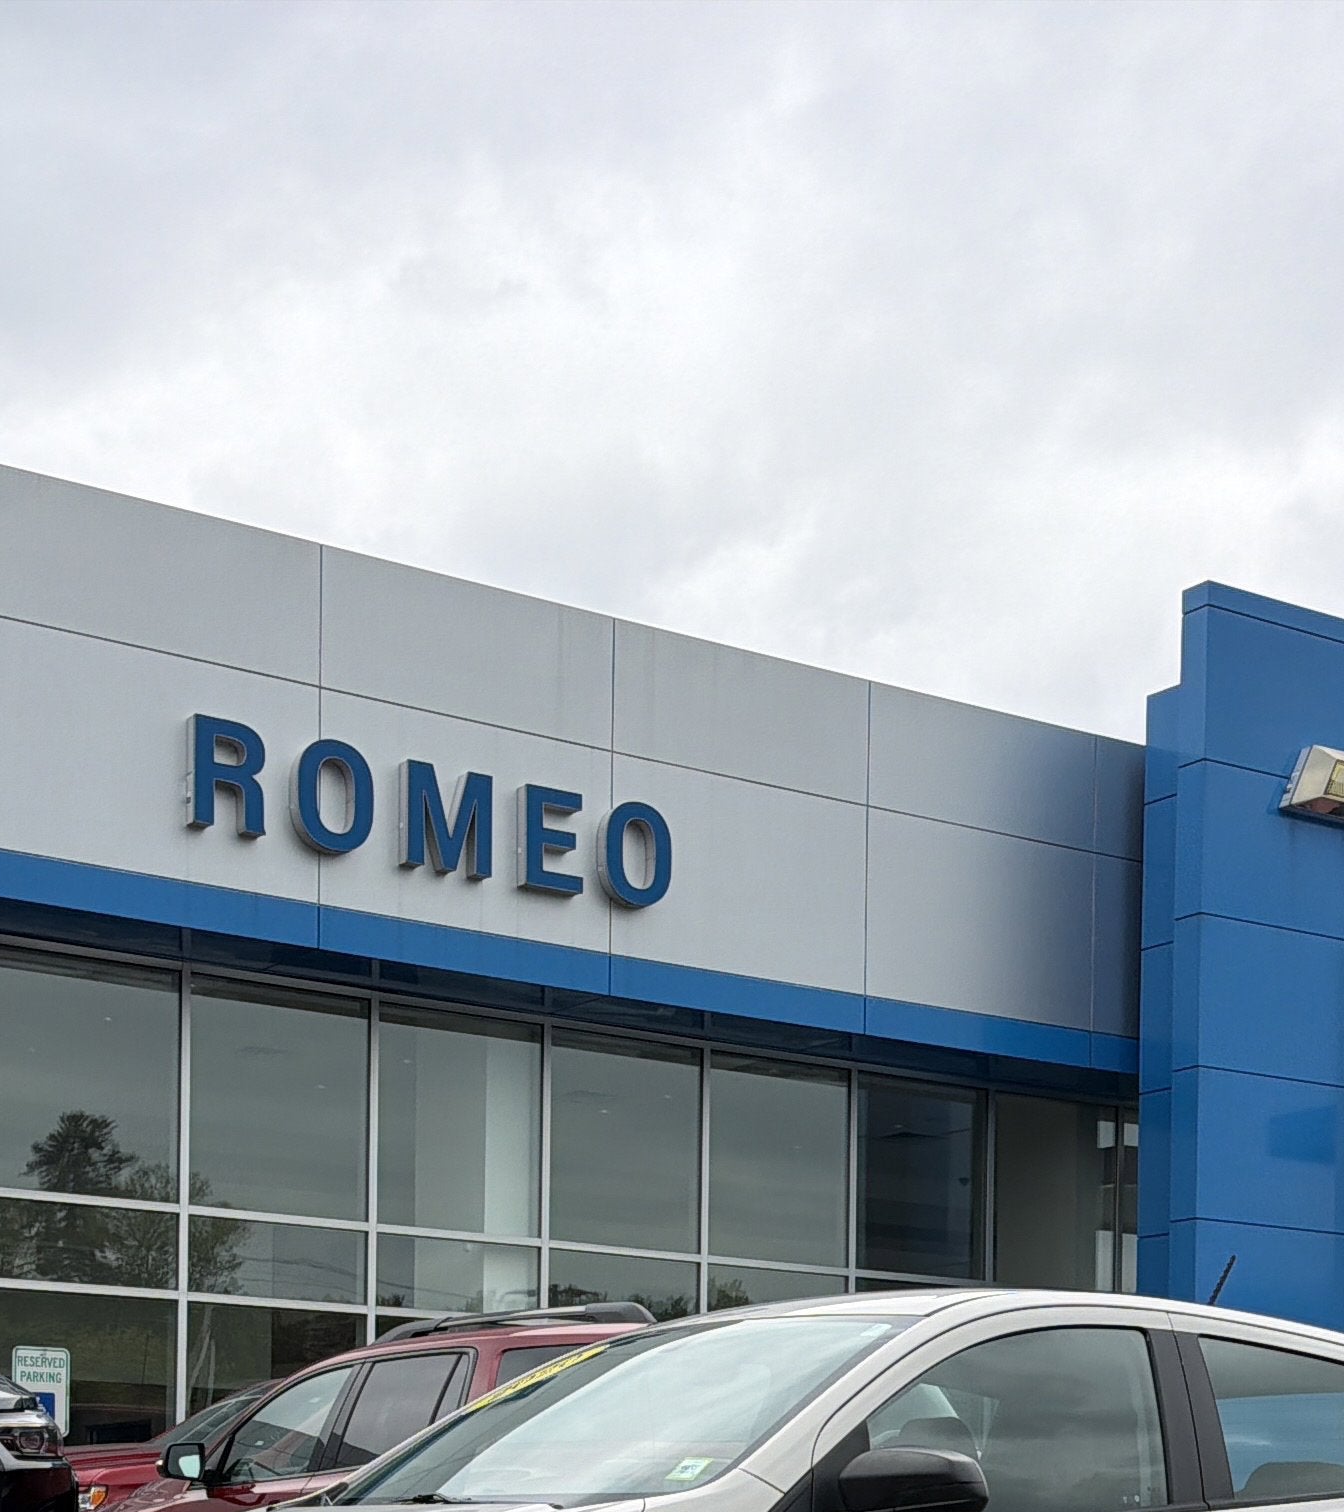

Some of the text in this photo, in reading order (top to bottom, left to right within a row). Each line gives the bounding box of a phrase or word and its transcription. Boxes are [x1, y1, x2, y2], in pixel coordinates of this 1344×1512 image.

[186, 713, 673, 910] ROMEO
[17, 1355, 65, 1369] RESERVED
[20, 1370, 62, 1383] PARKING
